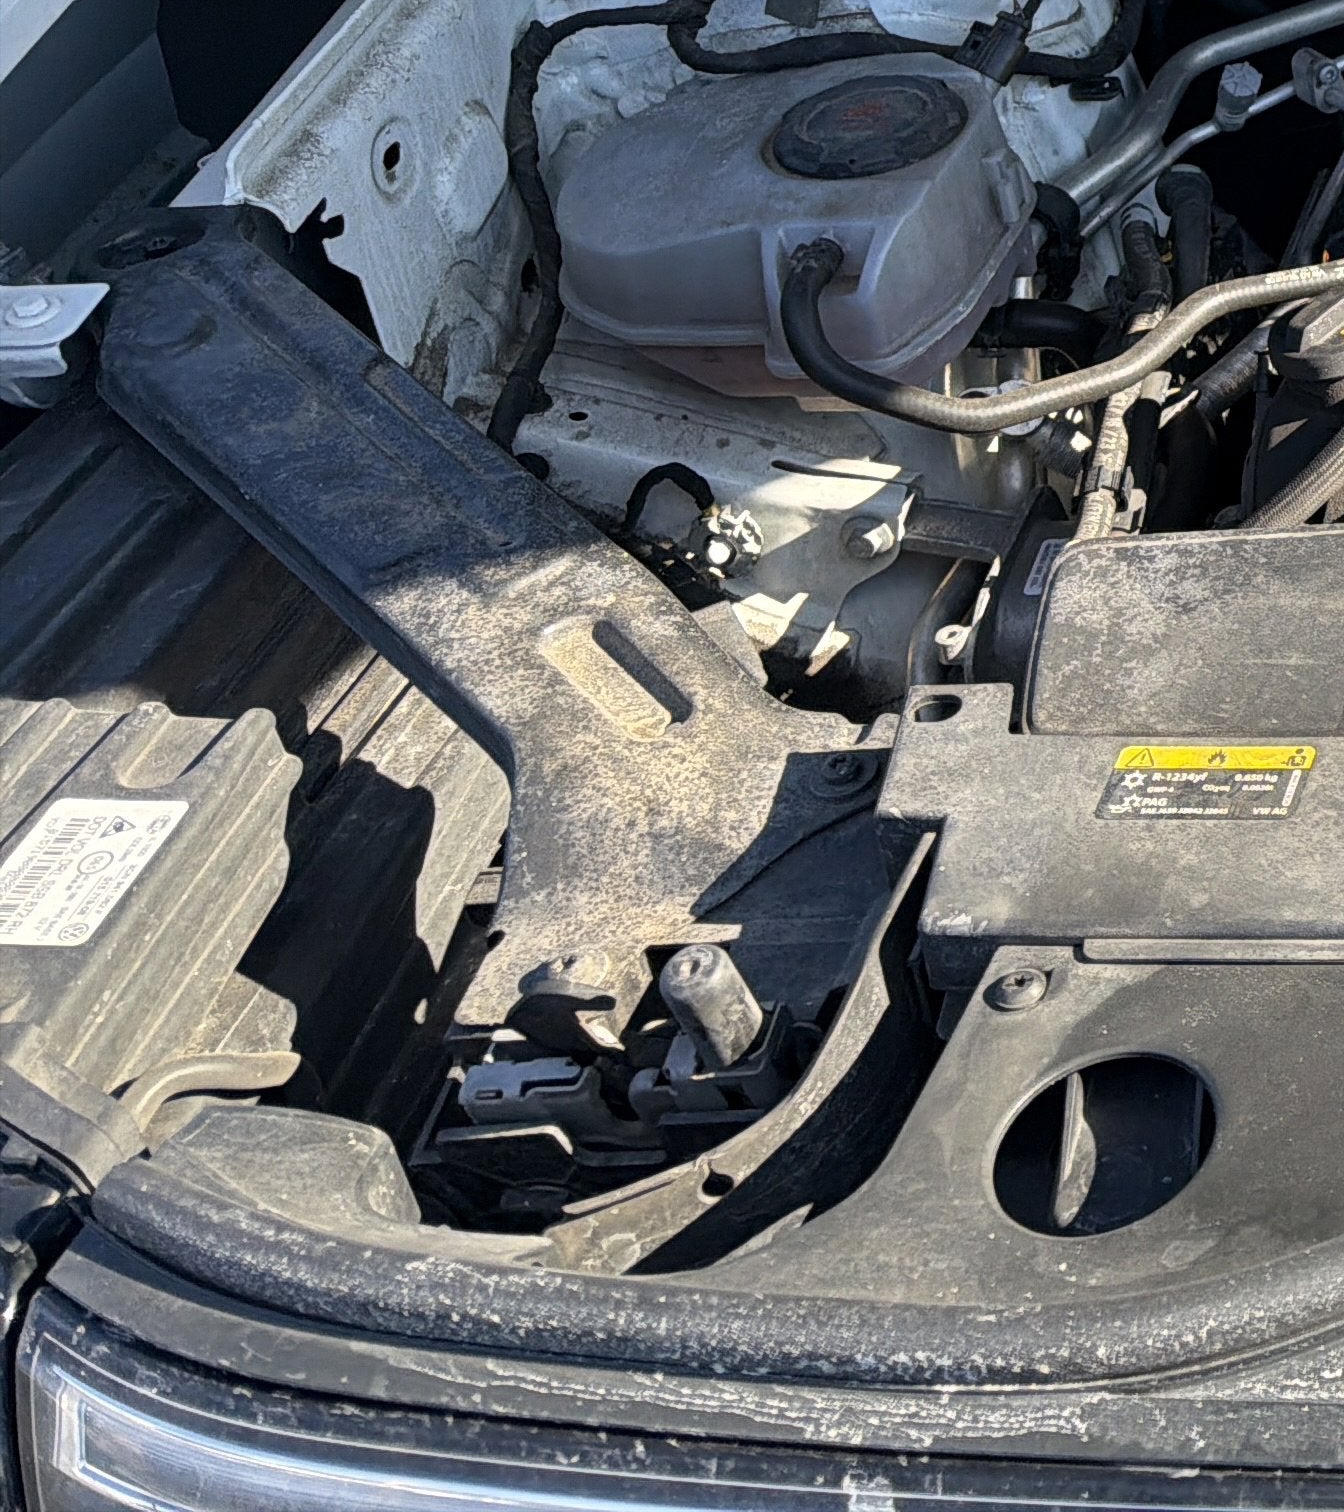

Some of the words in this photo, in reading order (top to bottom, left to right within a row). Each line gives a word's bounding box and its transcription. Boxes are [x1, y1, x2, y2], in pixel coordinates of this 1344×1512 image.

[1152, 772, 1208, 783] R-1234yf
[1142, 798, 1168, 806] PAG
[86, 817, 106, 835] DOT
